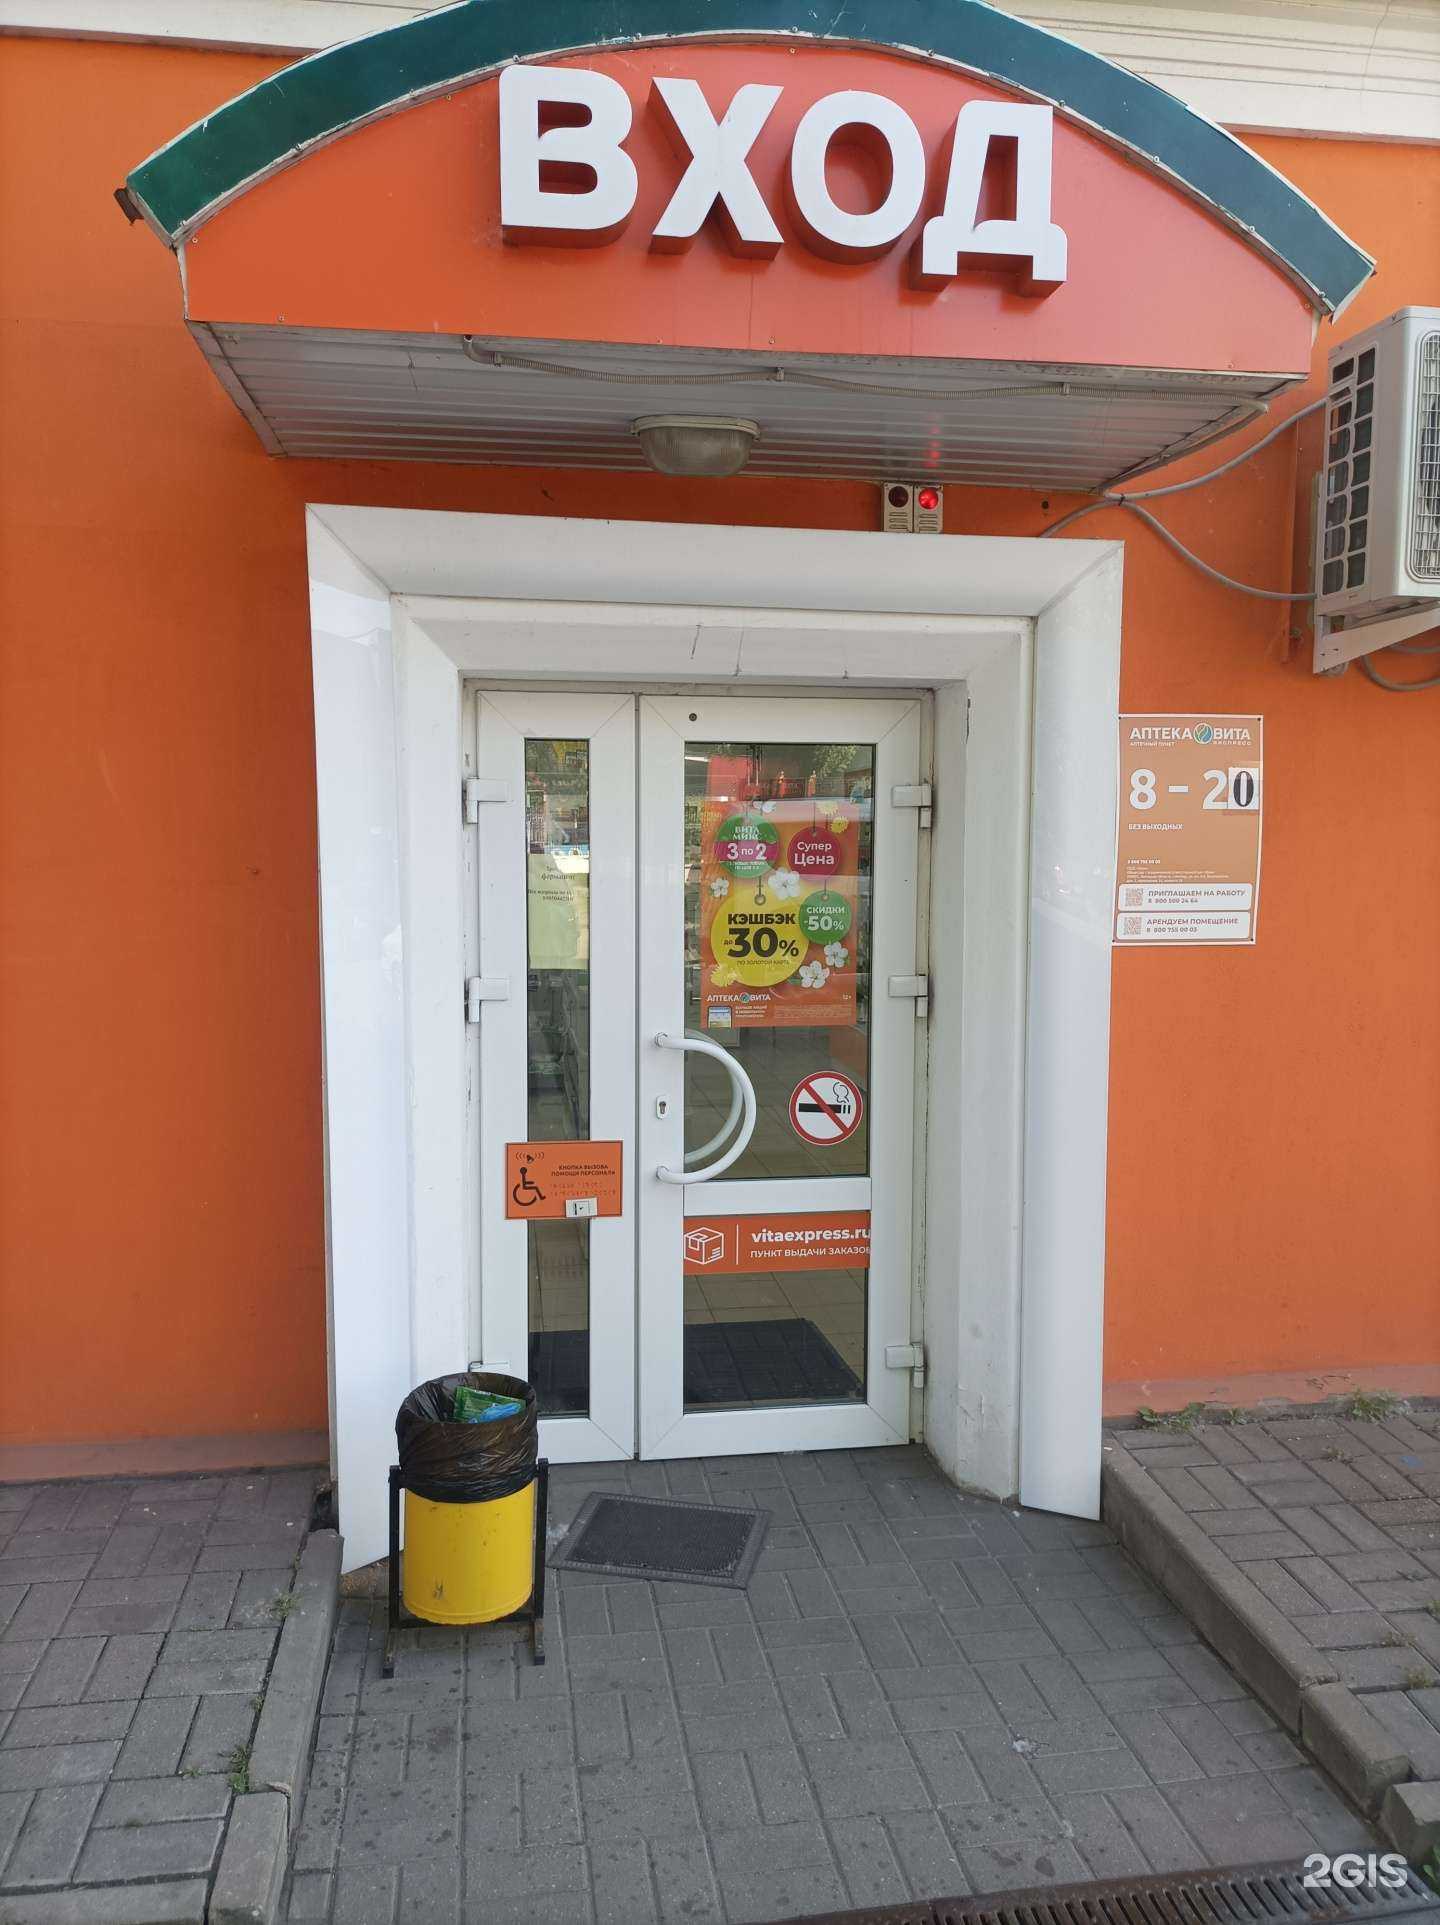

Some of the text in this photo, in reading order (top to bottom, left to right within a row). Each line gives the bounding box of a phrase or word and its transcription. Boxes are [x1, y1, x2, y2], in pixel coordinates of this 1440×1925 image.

[500, 64, 1067, 282] ВХОД
[1129, 727, 1251, 740] АПТЕКА ВИТА
[1129, 768, 1157, 810] 8
[1202, 769, 1255, 810] 20
[1142, 823, 1184, 831] ВЫХОДНЫХ
[727, 842, 739, 860] 3
[755, 843, 767, 860] 2
[797, 841, 832, 852] Супер
[794, 853, 835, 867] Цена
[727, 914, 797, 924] КЭШБЭК
[727, 927, 799, 958] 30%
[706, 993, 771, 1002] АПТЕКА ВИТА
[751, 1228, 871, 1244] vitaexpress.ru
[750, 1248, 782, 1259] ПУНКТ
[784, 1247, 827, 1258] ВЫДАЧИ
